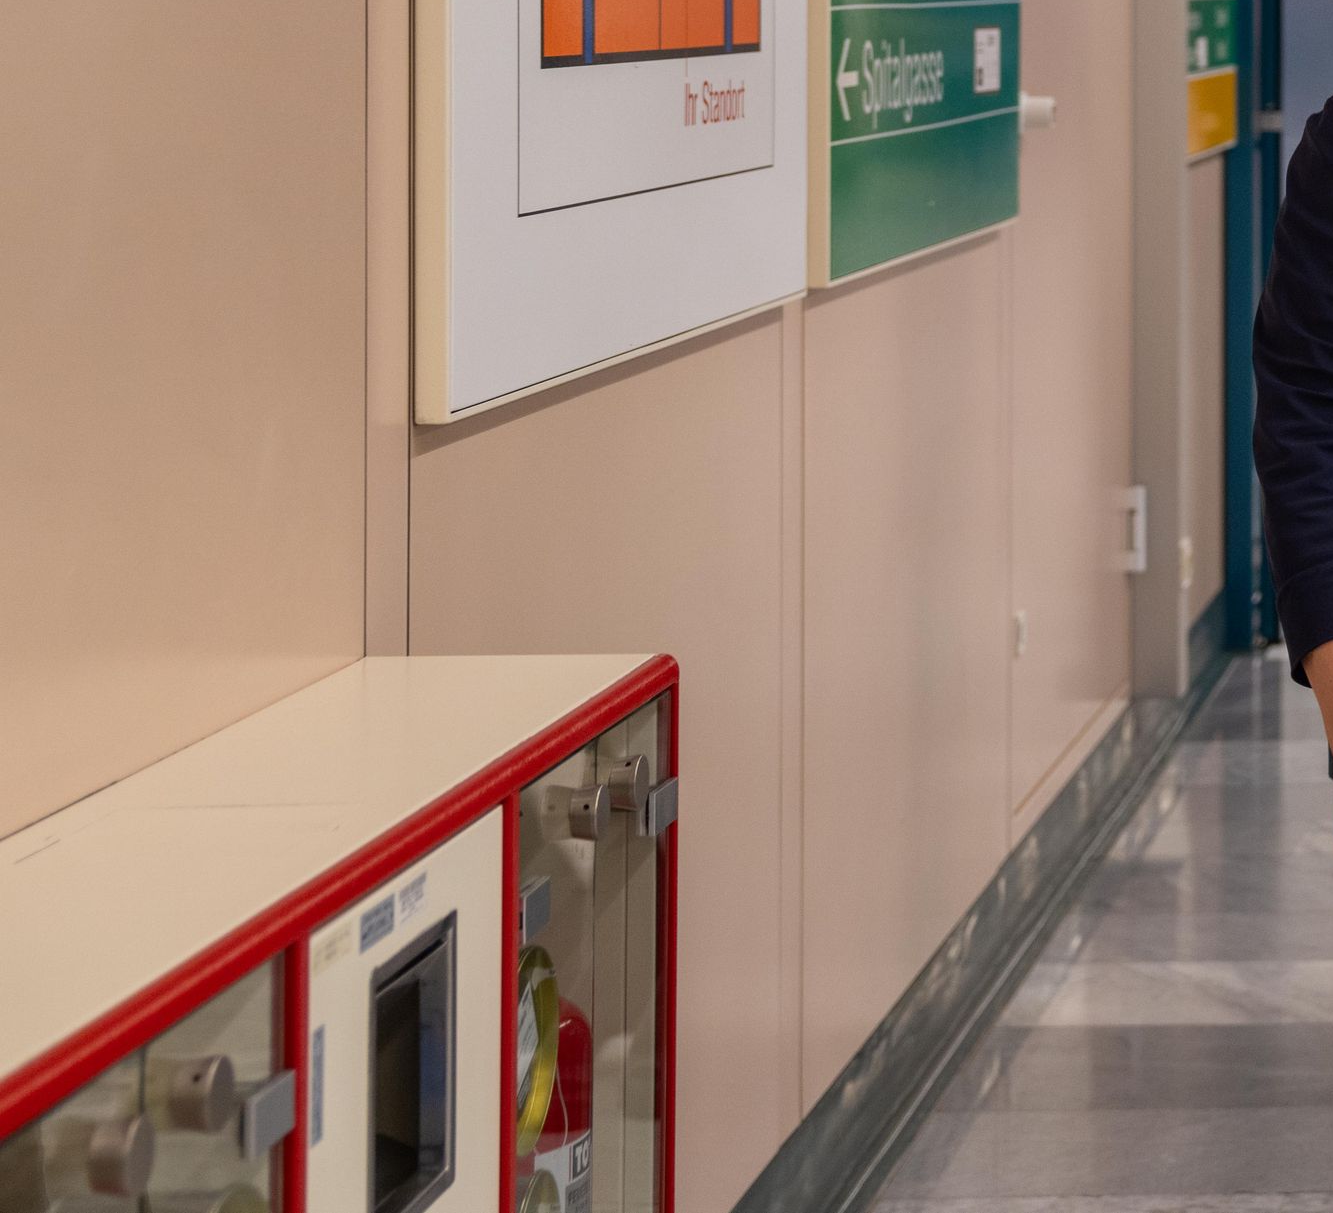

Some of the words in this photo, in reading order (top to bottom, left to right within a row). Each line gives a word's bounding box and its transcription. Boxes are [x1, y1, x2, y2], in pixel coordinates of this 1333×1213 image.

[683, 81, 698, 127] Ihr
[701, 77, 746, 125] Standort
[861, 38, 945, 129] Spitalgasse
